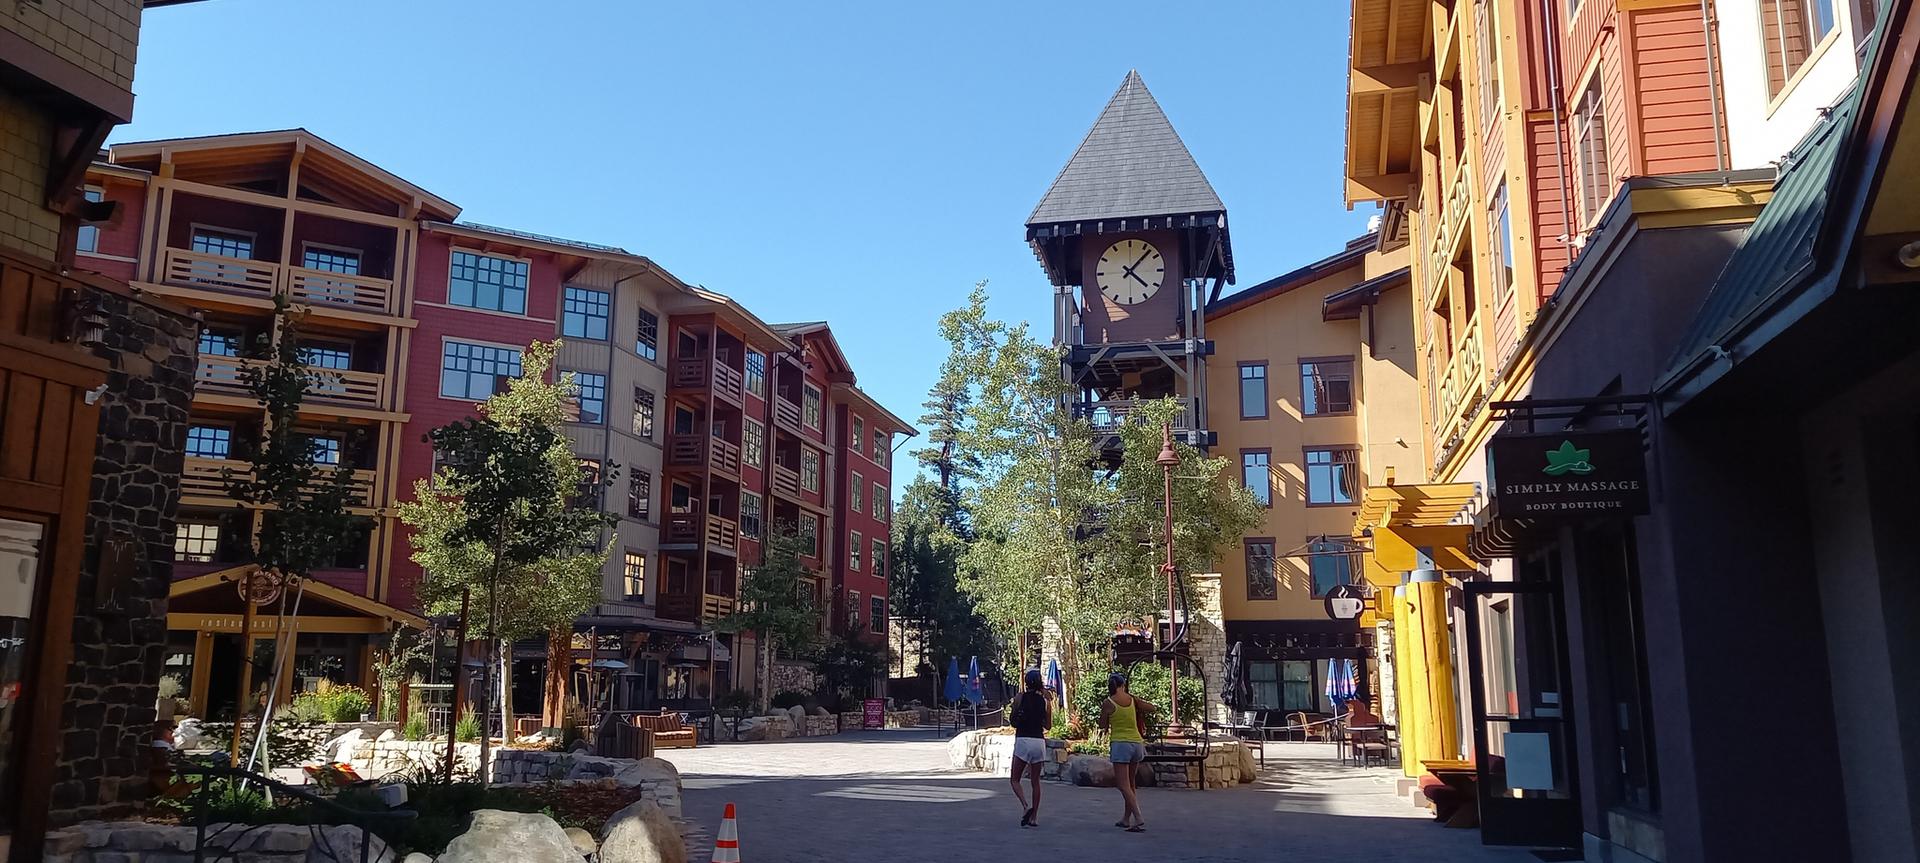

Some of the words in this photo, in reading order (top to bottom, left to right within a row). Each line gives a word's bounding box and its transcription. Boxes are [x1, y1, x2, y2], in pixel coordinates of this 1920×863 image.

[1506, 483, 1562, 495] SIMPLY
[1567, 480, 1639, 492] MASSAGE
[1526, 503, 1556, 511] BODY
[1561, 501, 1622, 510] BOUTIQUE
[200, 618, 272, 628] restauant
